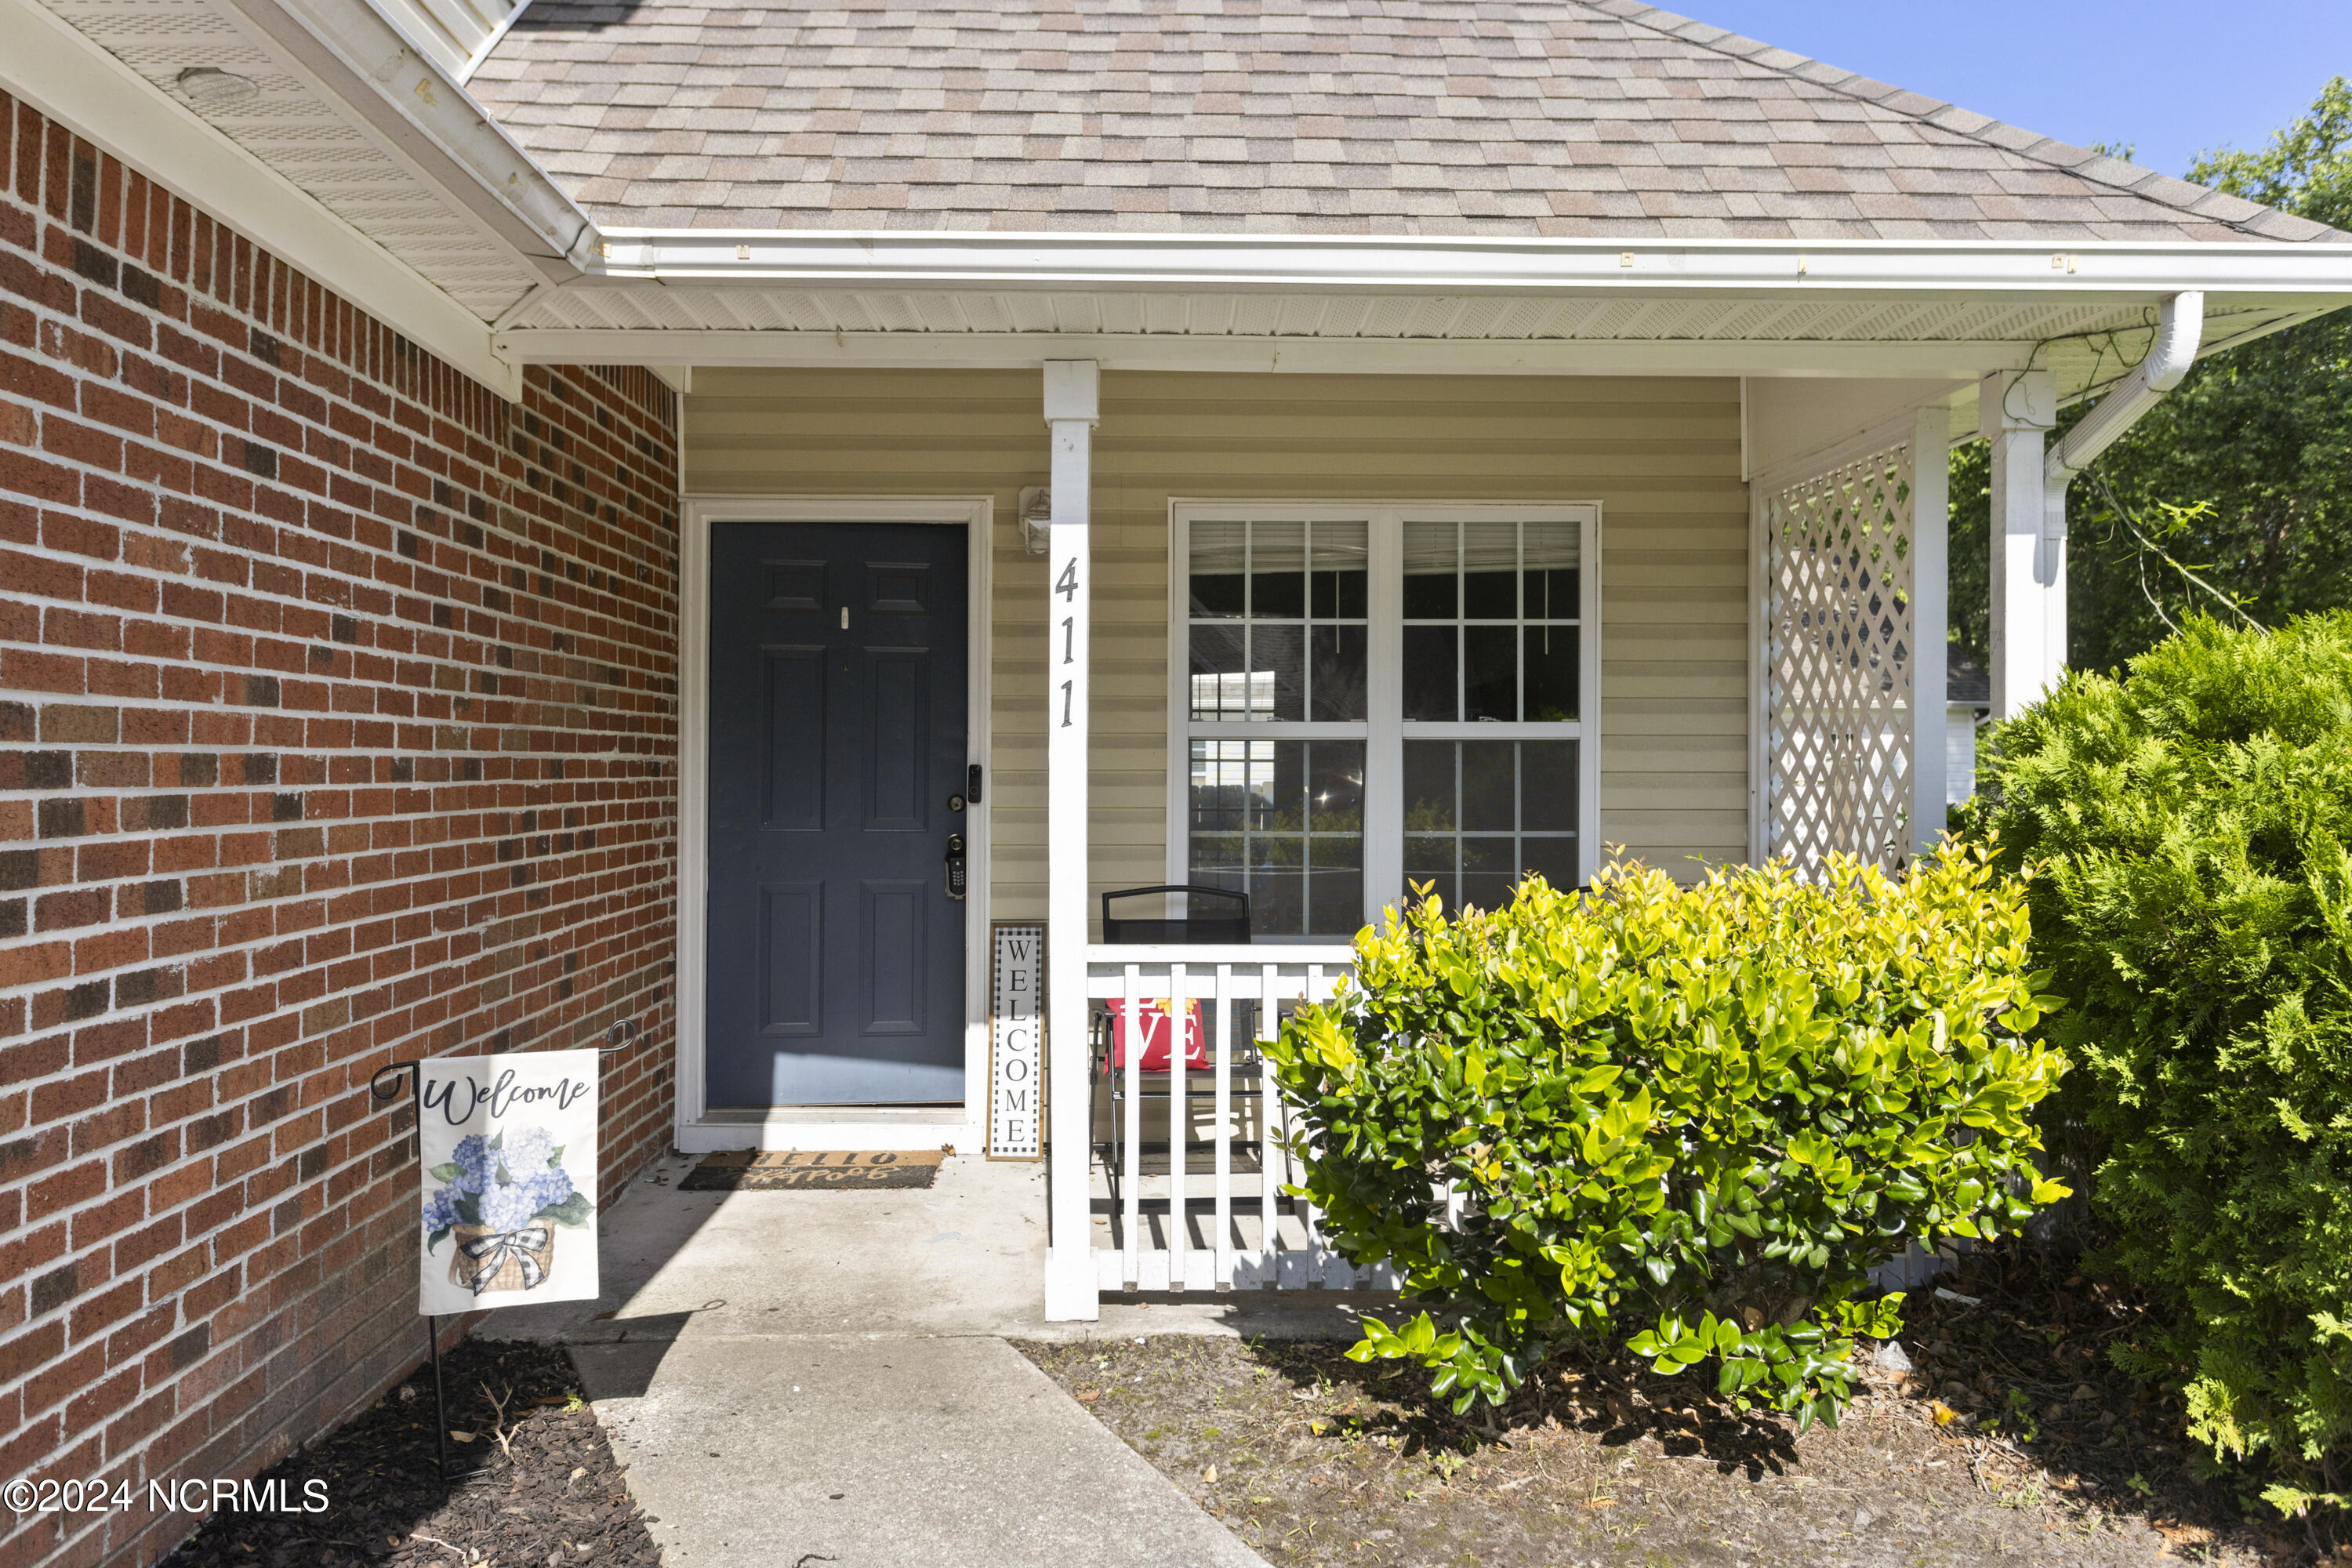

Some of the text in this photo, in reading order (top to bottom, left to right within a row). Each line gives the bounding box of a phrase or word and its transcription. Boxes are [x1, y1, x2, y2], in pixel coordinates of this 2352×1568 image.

[1055, 557, 1078, 728] 411
[423, 1069, 590, 1126] Welcome
[1005, 940, 1032, 1142] WELCOME
